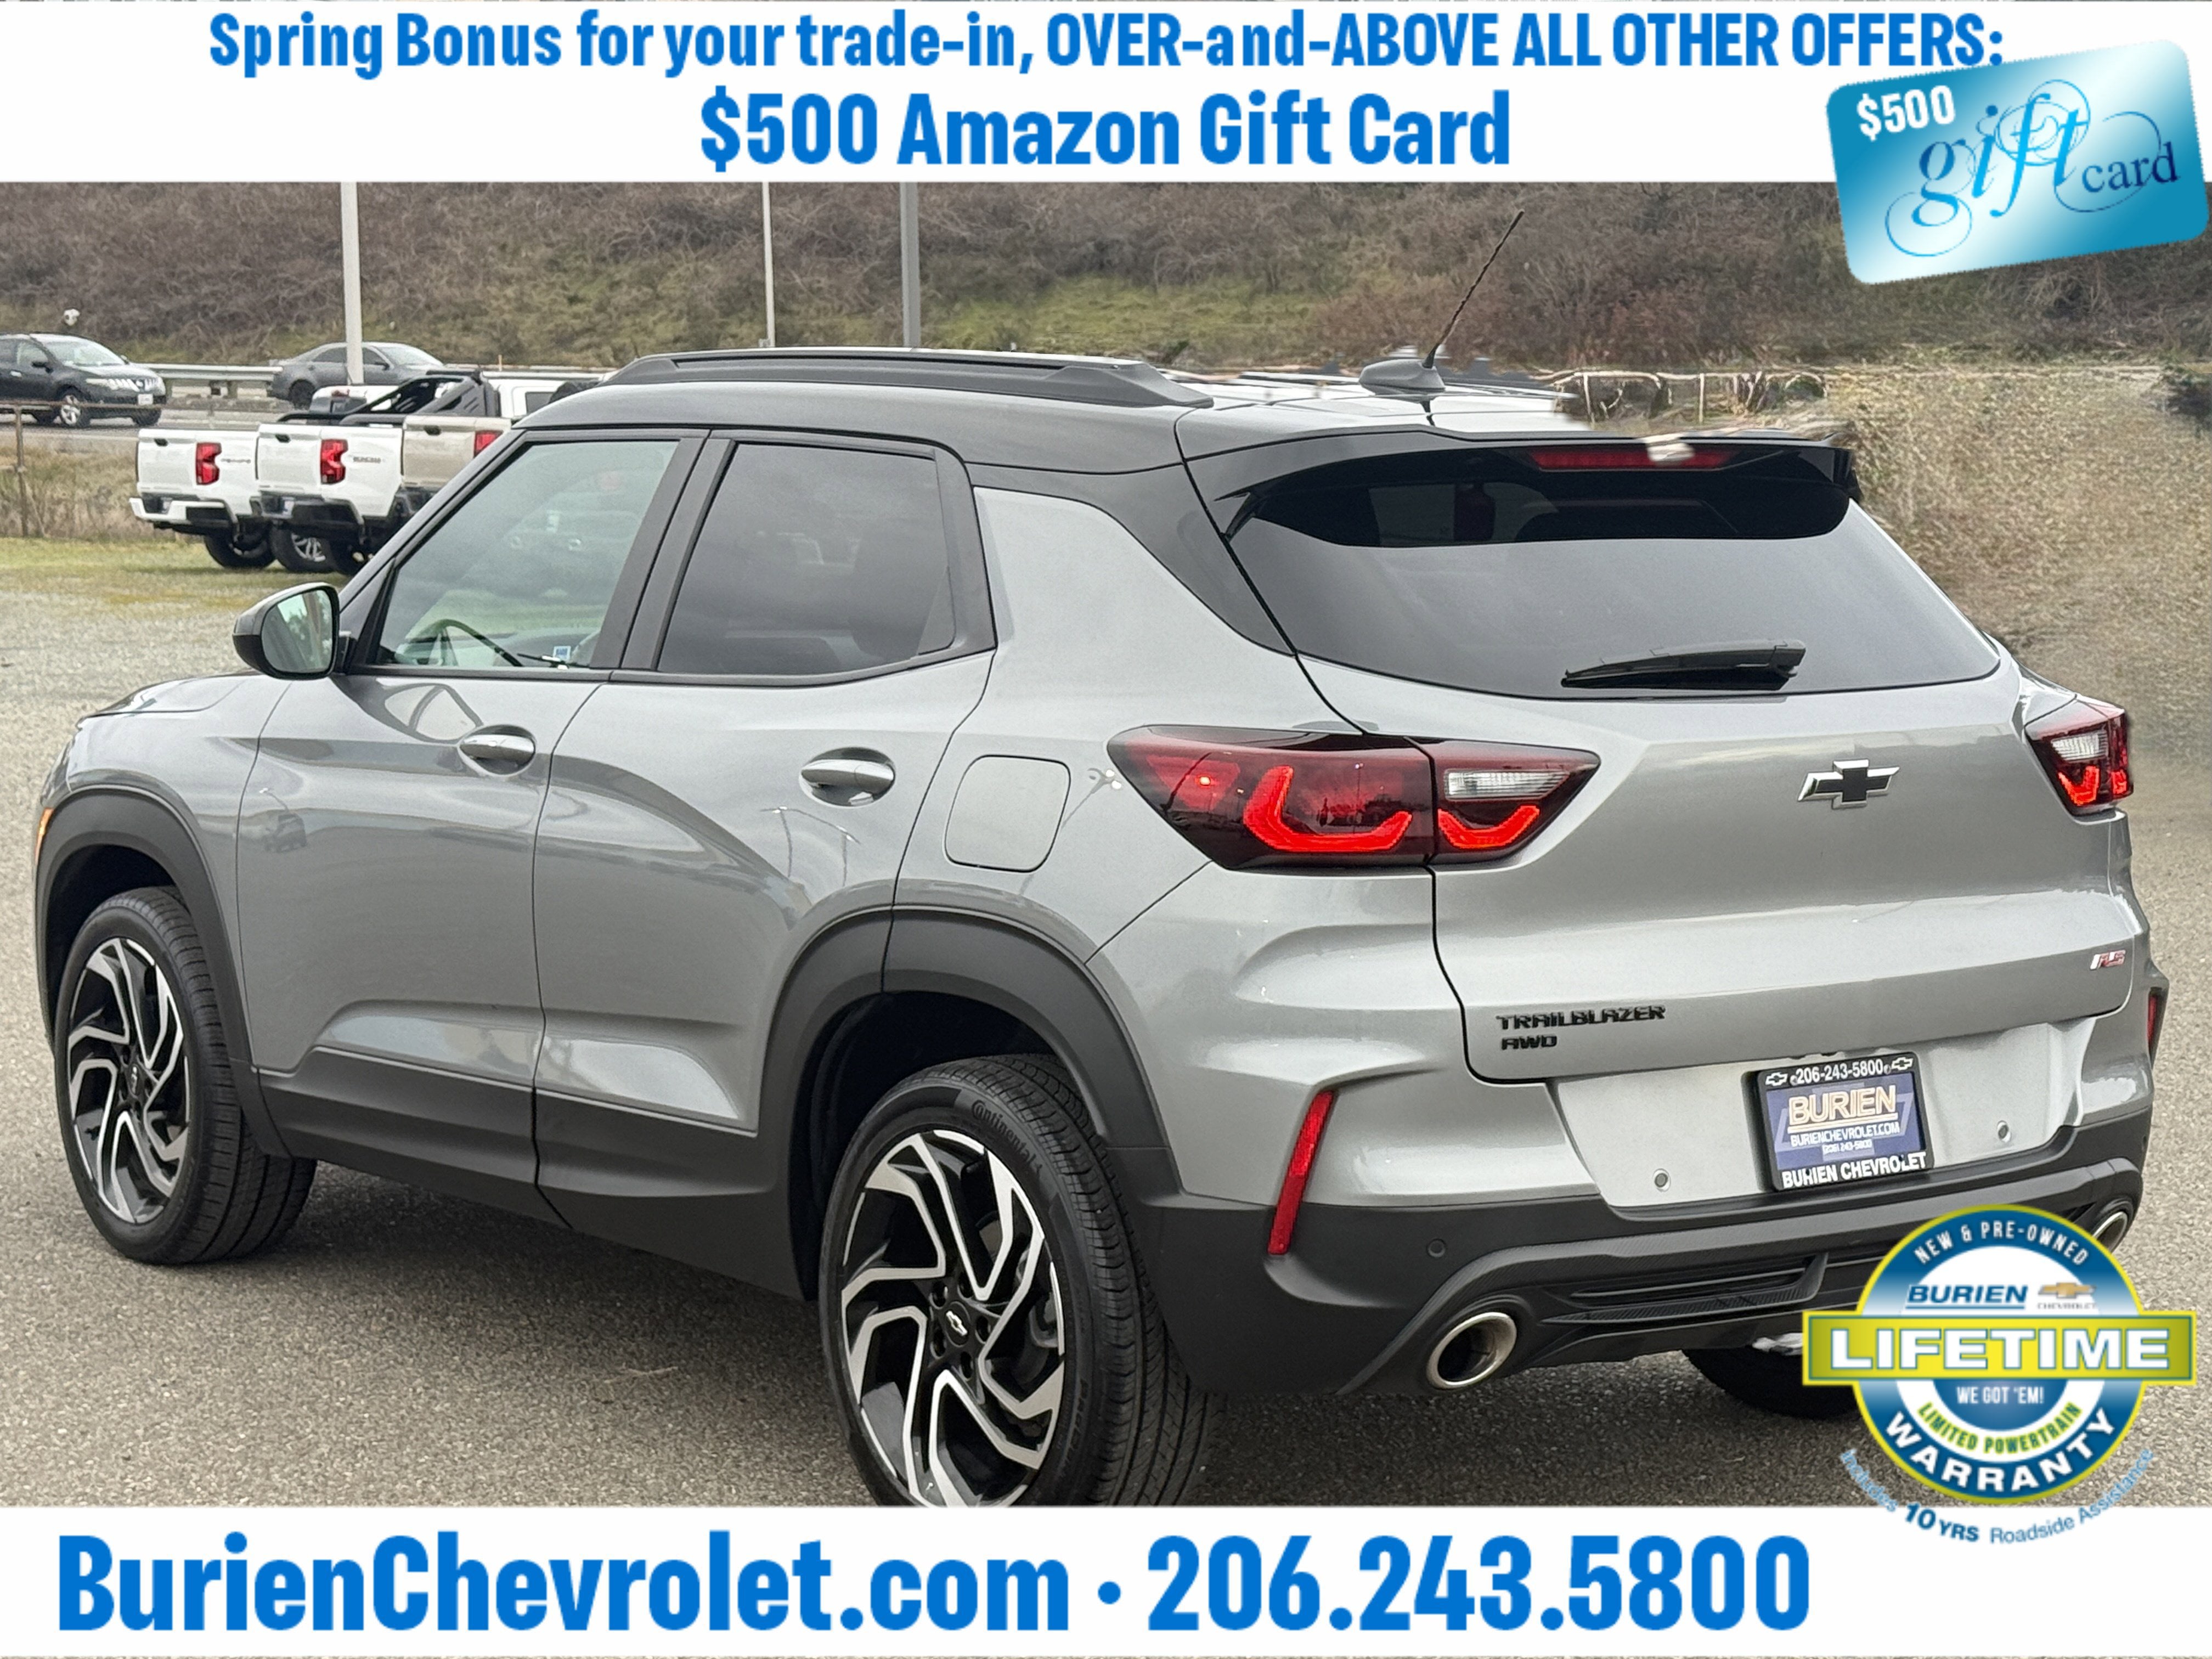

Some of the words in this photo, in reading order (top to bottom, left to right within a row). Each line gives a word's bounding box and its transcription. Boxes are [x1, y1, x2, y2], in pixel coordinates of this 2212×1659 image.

[1496, 1005, 1666, 1030] TRAILBLAZER
[1501, 1034, 1558, 1050] AWD
[1795, 1059, 1884, 1085] 206-243-5800
[1788, 1085, 1897, 1126] BURIEN
[1840, 1152, 1927, 1179] CHEVROLET
